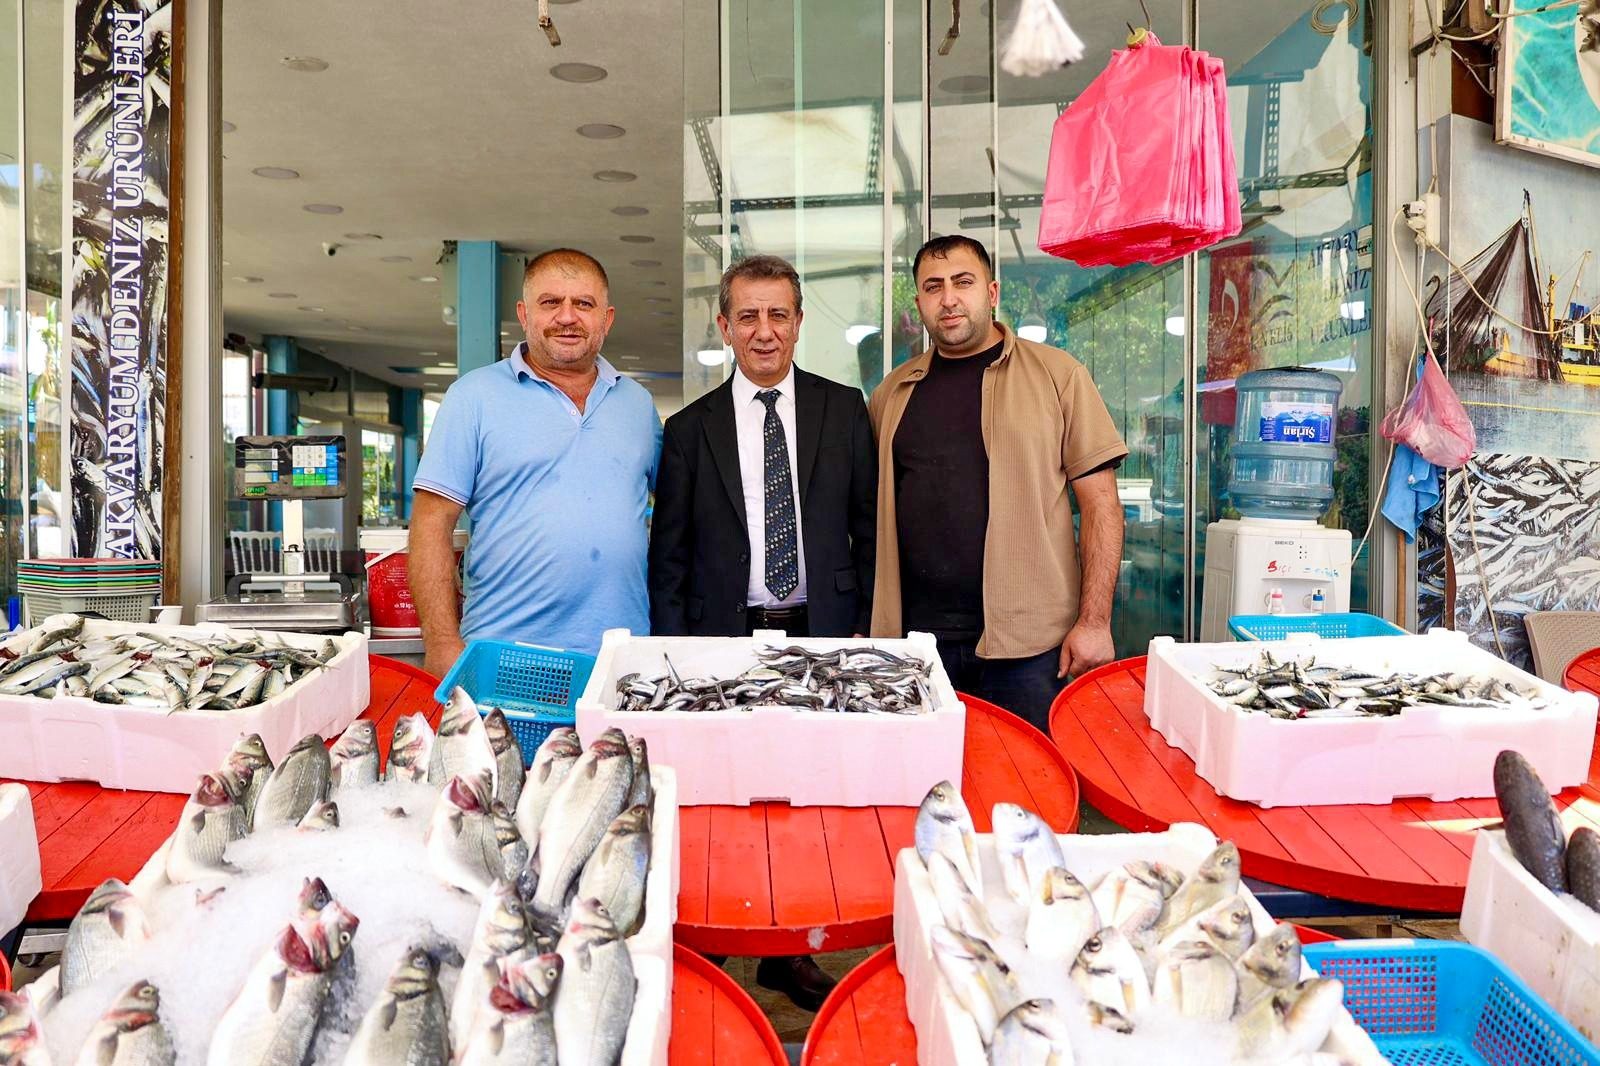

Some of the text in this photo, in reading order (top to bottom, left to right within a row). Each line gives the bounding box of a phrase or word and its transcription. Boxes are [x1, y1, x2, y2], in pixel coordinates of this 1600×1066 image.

[104, 10, 146, 560] AKVARYUM DENİZ ÜRÜNLERİ
[1283, 425, 1316, 439] Şırlan
